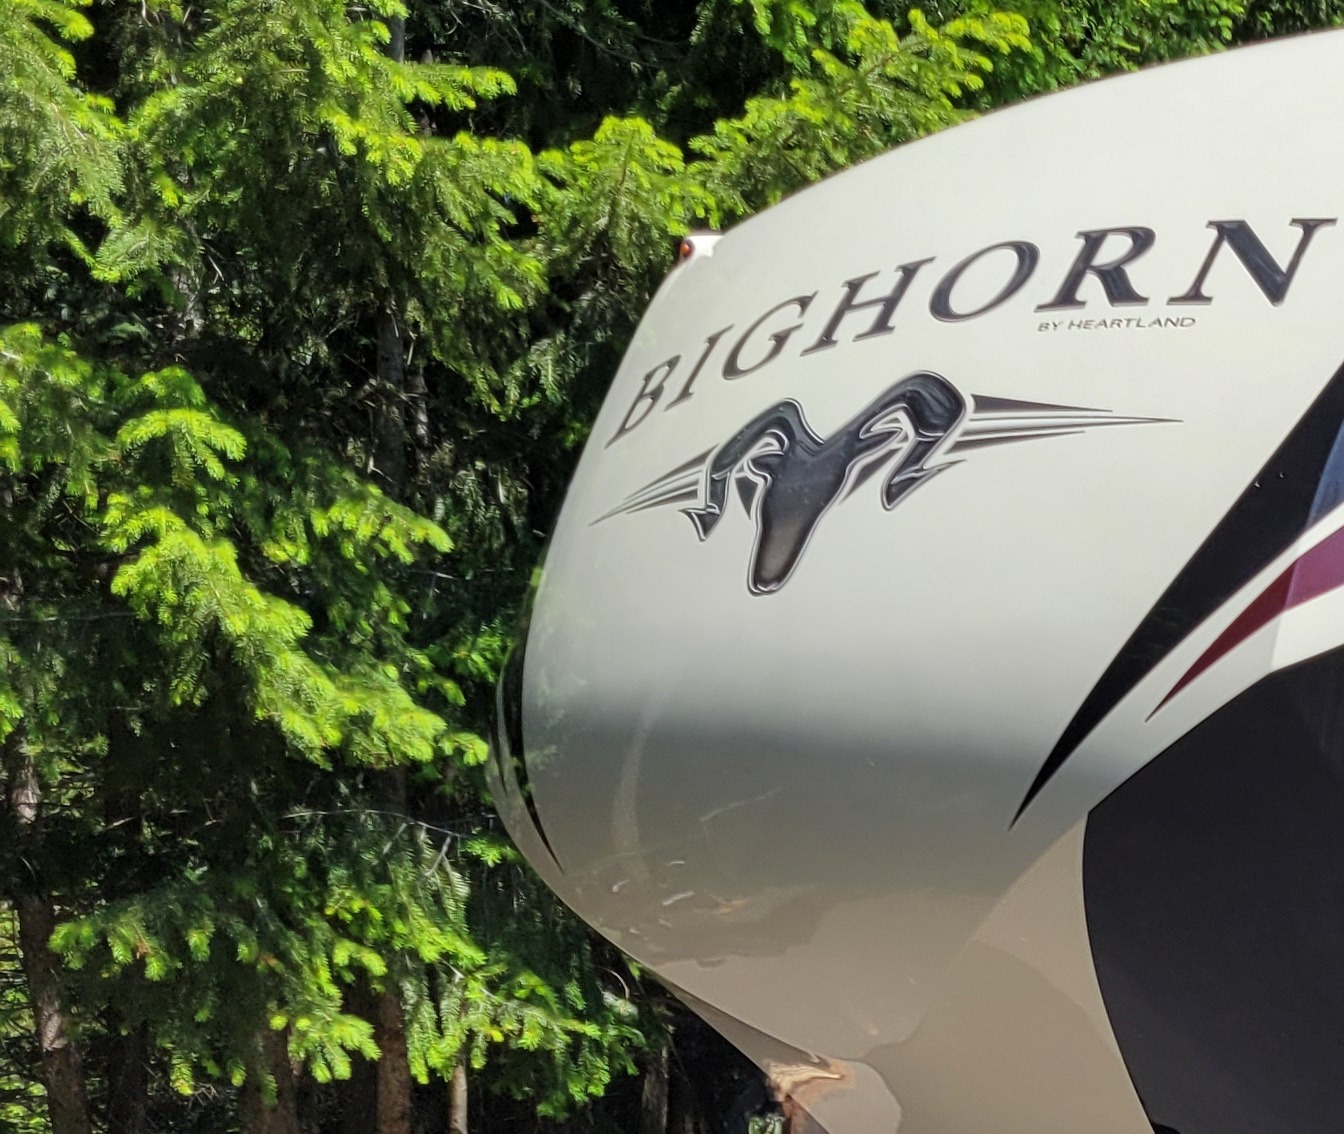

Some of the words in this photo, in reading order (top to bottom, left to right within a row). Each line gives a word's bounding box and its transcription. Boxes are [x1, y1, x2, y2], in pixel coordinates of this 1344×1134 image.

[604, 217, 1338, 449] BIGHORN
[1037, 321, 1061, 332] BY
[1067, 317, 1197, 331] HEARTLAND
